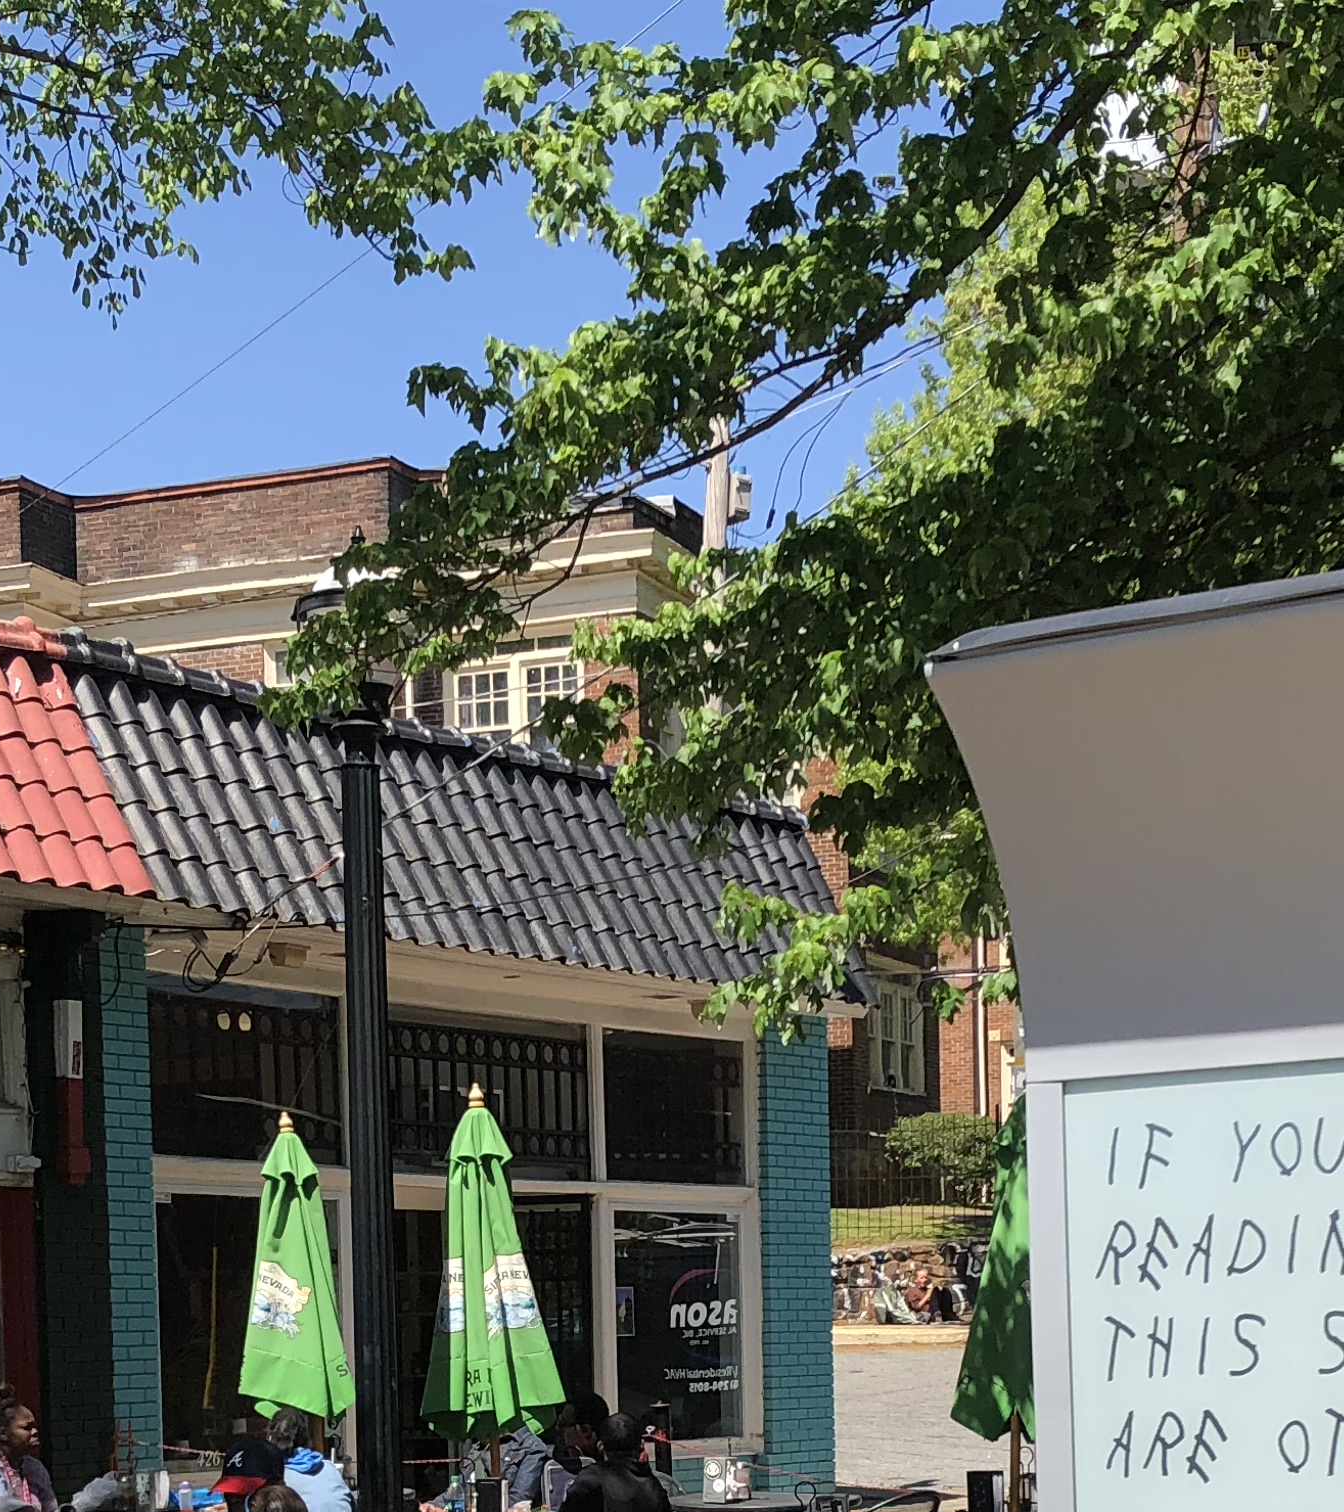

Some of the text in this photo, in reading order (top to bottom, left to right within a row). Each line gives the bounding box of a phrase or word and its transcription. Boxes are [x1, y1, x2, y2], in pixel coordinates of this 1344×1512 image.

[1108, 1123, 1173, 1189] IF
[1104, 1312, 1267, 1382] THIS
[1106, 1409, 1228, 1483] ARE
